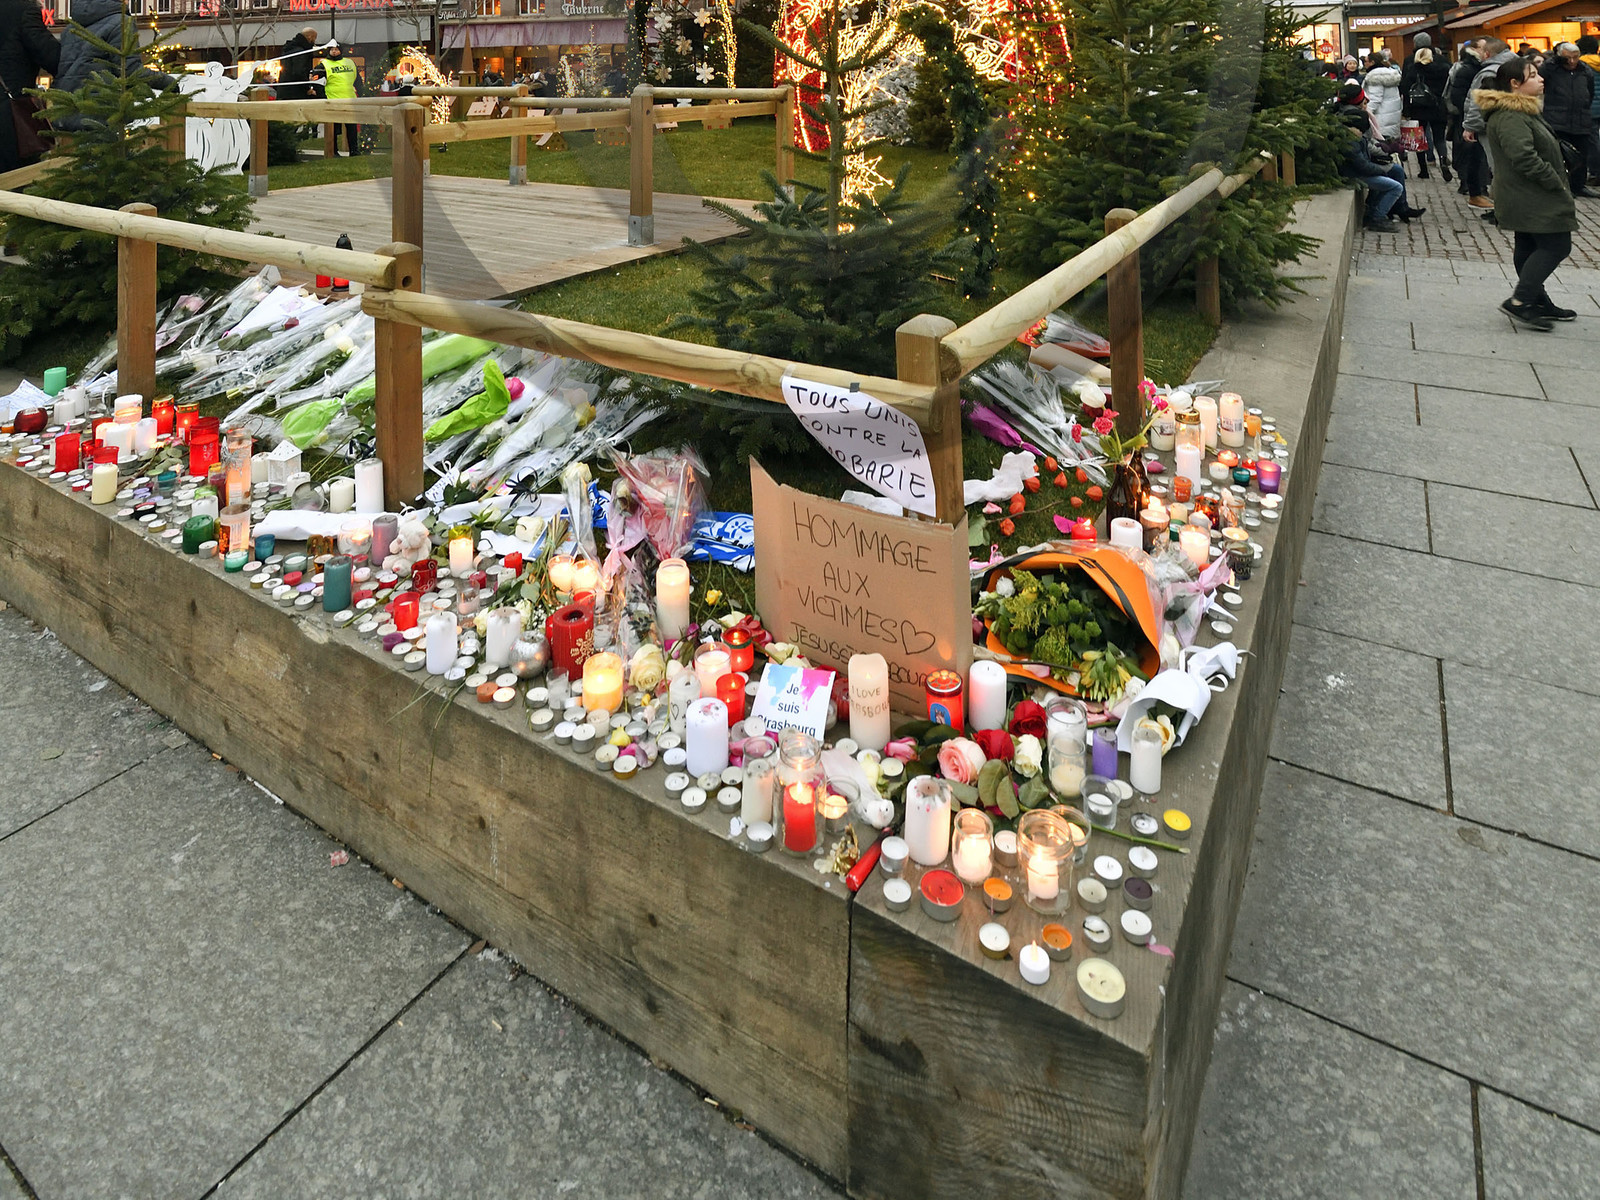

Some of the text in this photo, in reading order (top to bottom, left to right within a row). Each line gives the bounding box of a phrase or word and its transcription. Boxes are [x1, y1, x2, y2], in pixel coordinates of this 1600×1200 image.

[561, 3, 605, 16] Taverne
[1356, 17, 1395, 26] COMPTOIR
[1396, 17, 1408, 25] DE
[790, 385, 918, 437] TOUS UNIS
[799, 414, 921, 460] CONTRE LA
[793, 501, 937, 574] HOMMAGE
[823, 561, 870, 598] AUX
[797, 585, 898, 644] VICTIMES
[786, 683, 800, 696] Je
[856, 686, 882, 699] LOVE
[777, 701, 800, 715] suis
[757, 714, 816, 738] rasburg
